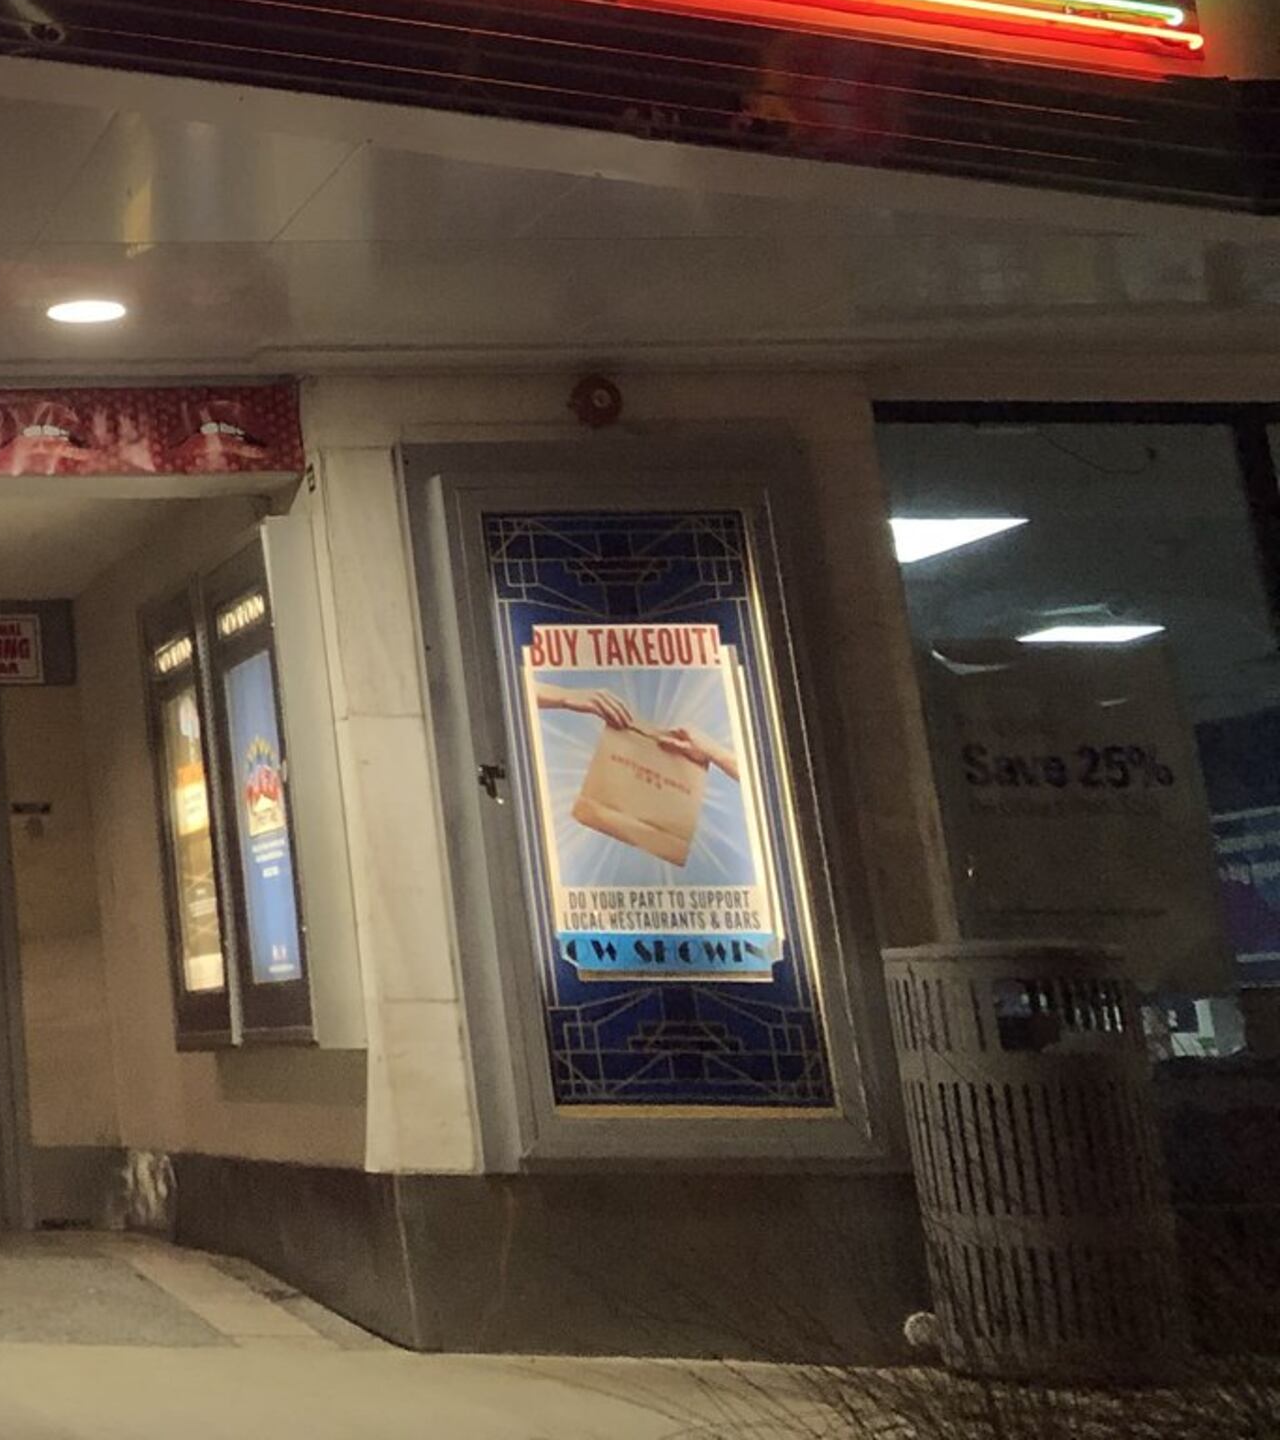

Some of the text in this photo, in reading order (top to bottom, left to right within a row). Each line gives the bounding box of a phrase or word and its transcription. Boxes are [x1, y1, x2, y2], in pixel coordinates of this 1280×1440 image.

[530, 627, 721, 666] BUY TAKEOUT!
[961, 742, 1176, 790] Save 25%
[568, 890, 750, 910] DO YOUR PART TO SUPPORT
[563, 911, 762, 930] LOCAL RESTAURANTS & BARS
[566, 938, 768, 964] OW SHOWIN
